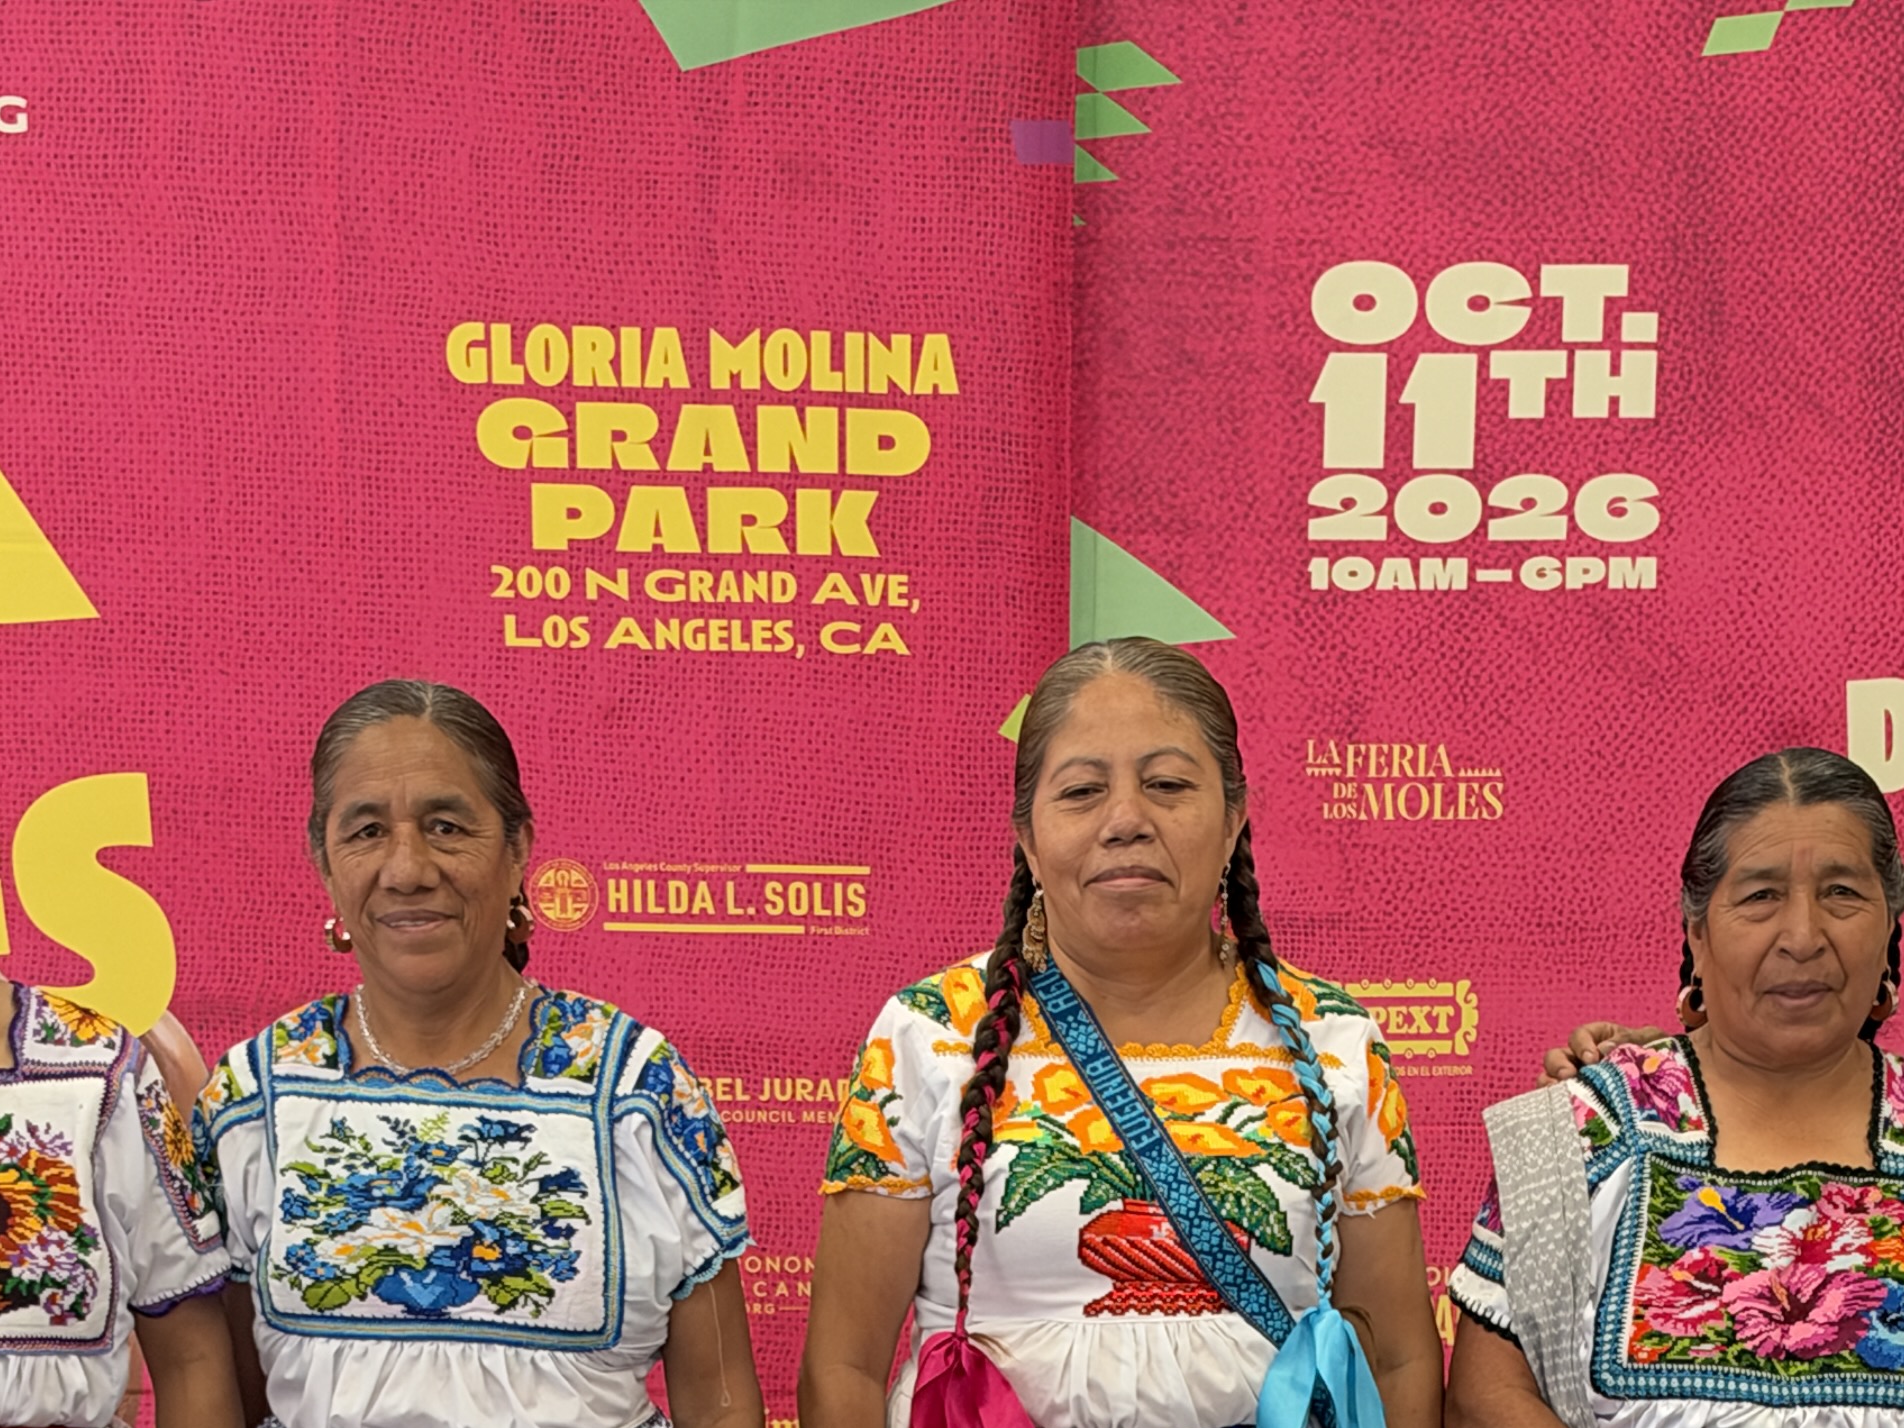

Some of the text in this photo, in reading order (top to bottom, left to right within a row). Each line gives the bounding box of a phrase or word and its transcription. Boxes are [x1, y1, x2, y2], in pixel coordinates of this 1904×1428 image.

[1311, 261, 1658, 345] OCT.
[446, 322, 959, 395] GLORIA MOLINA
[477, 398, 930, 476] GRAND
[1309, 350, 1657, 469] 11TH
[531, 483, 880, 557] PARK
[1308, 473, 1660, 543] 2026
[491, 565, 919, 613] 200 N GRAND AVE,
[504, 615, 910, 658] LOS ANGELES, CA
[1307, 740, 1454, 777] LA FERIA
[1323, 782, 1503, 820] LOS MOLES
[1333, 783, 1357, 798] DE
[608, 879, 715, 914] HILDA
[726, 881, 755, 914] L.
[765, 881, 865, 917] SOLIS
[720, 1110, 795, 1123] COUNCIL
[1086, 1052, 1161, 1156] EUGENIA
